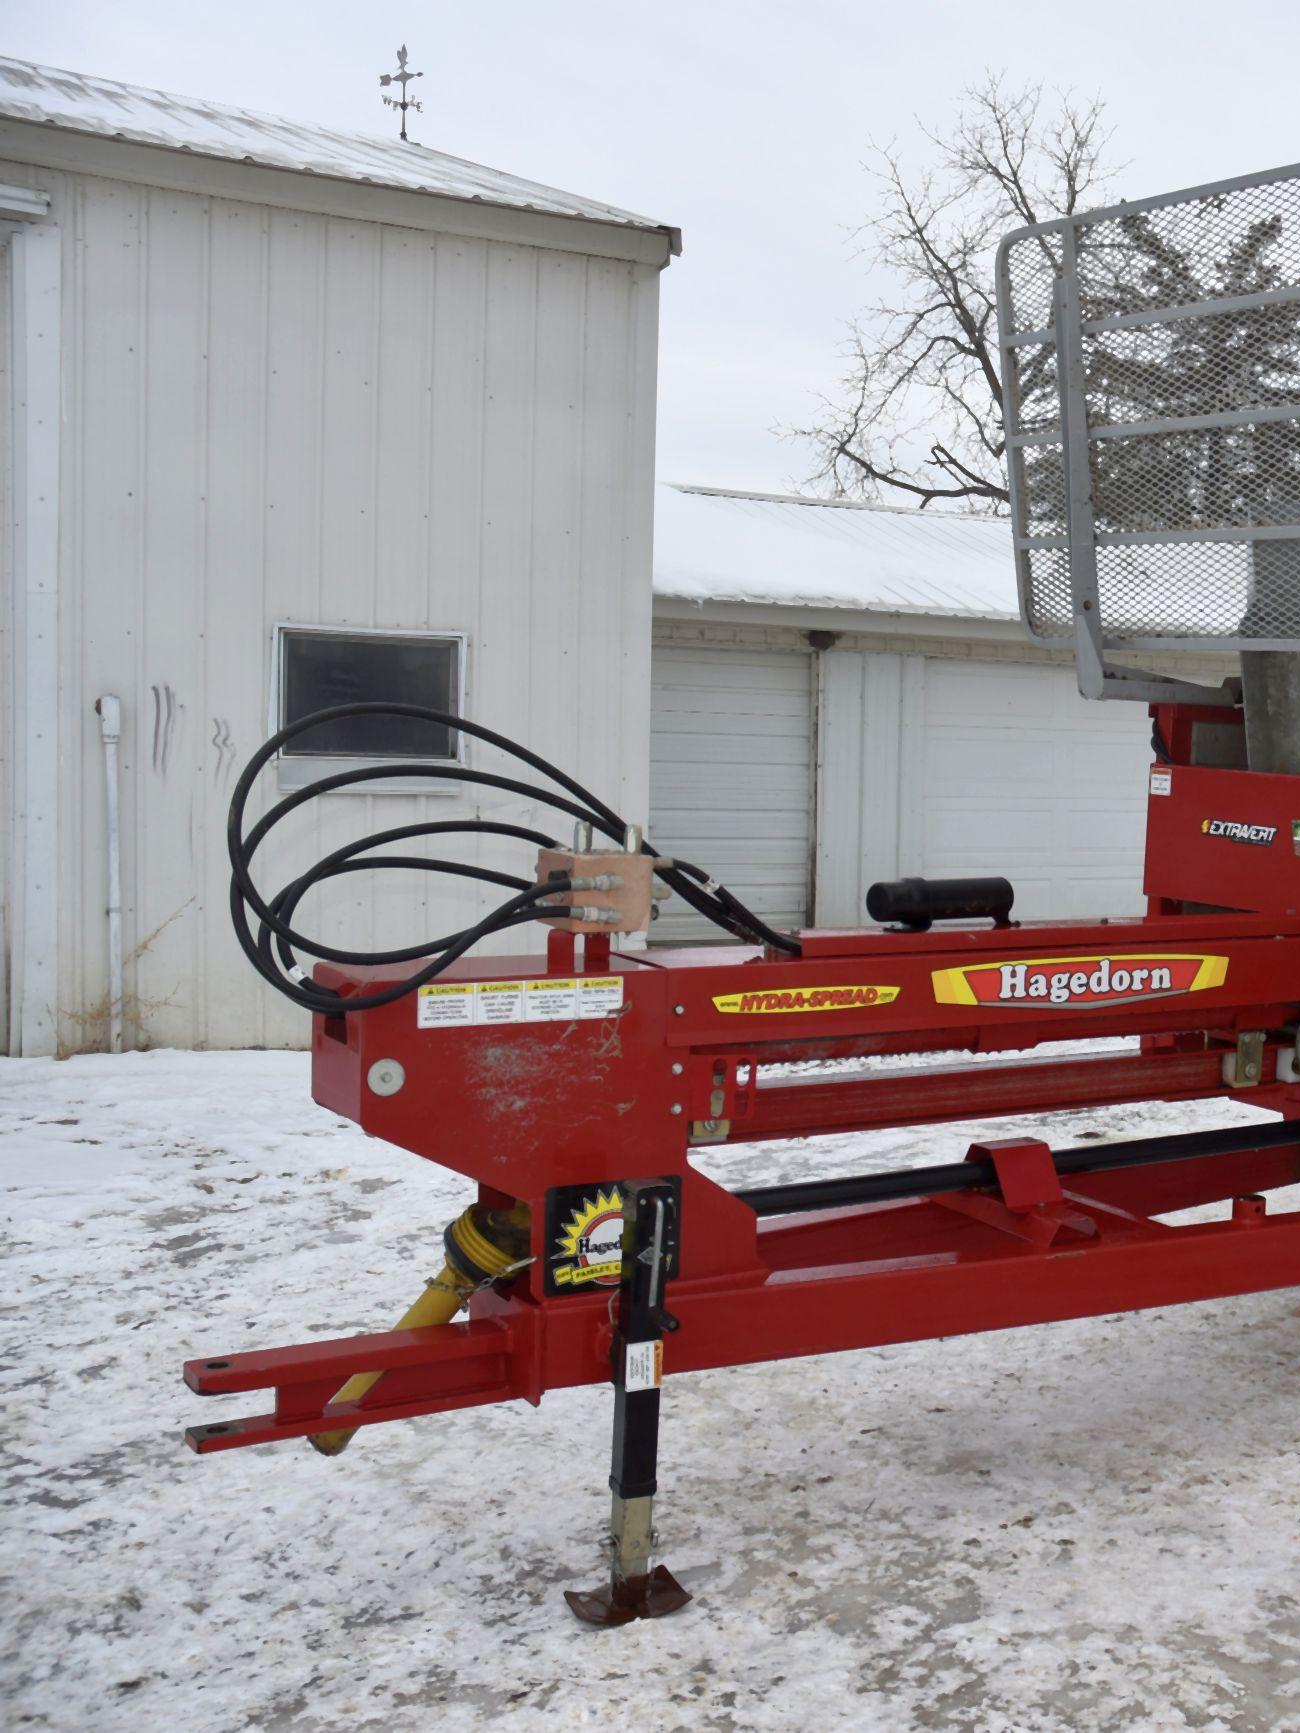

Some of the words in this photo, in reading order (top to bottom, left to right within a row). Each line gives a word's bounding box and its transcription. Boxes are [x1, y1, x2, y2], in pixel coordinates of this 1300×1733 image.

[1208, 820, 1277, 841] EXTRAVERT
[998, 957, 1172, 1003] Hagedorn
[739, 988, 878, 1012] HYDRA-SPREAD
[578, 1233, 622, 1256] Haged
